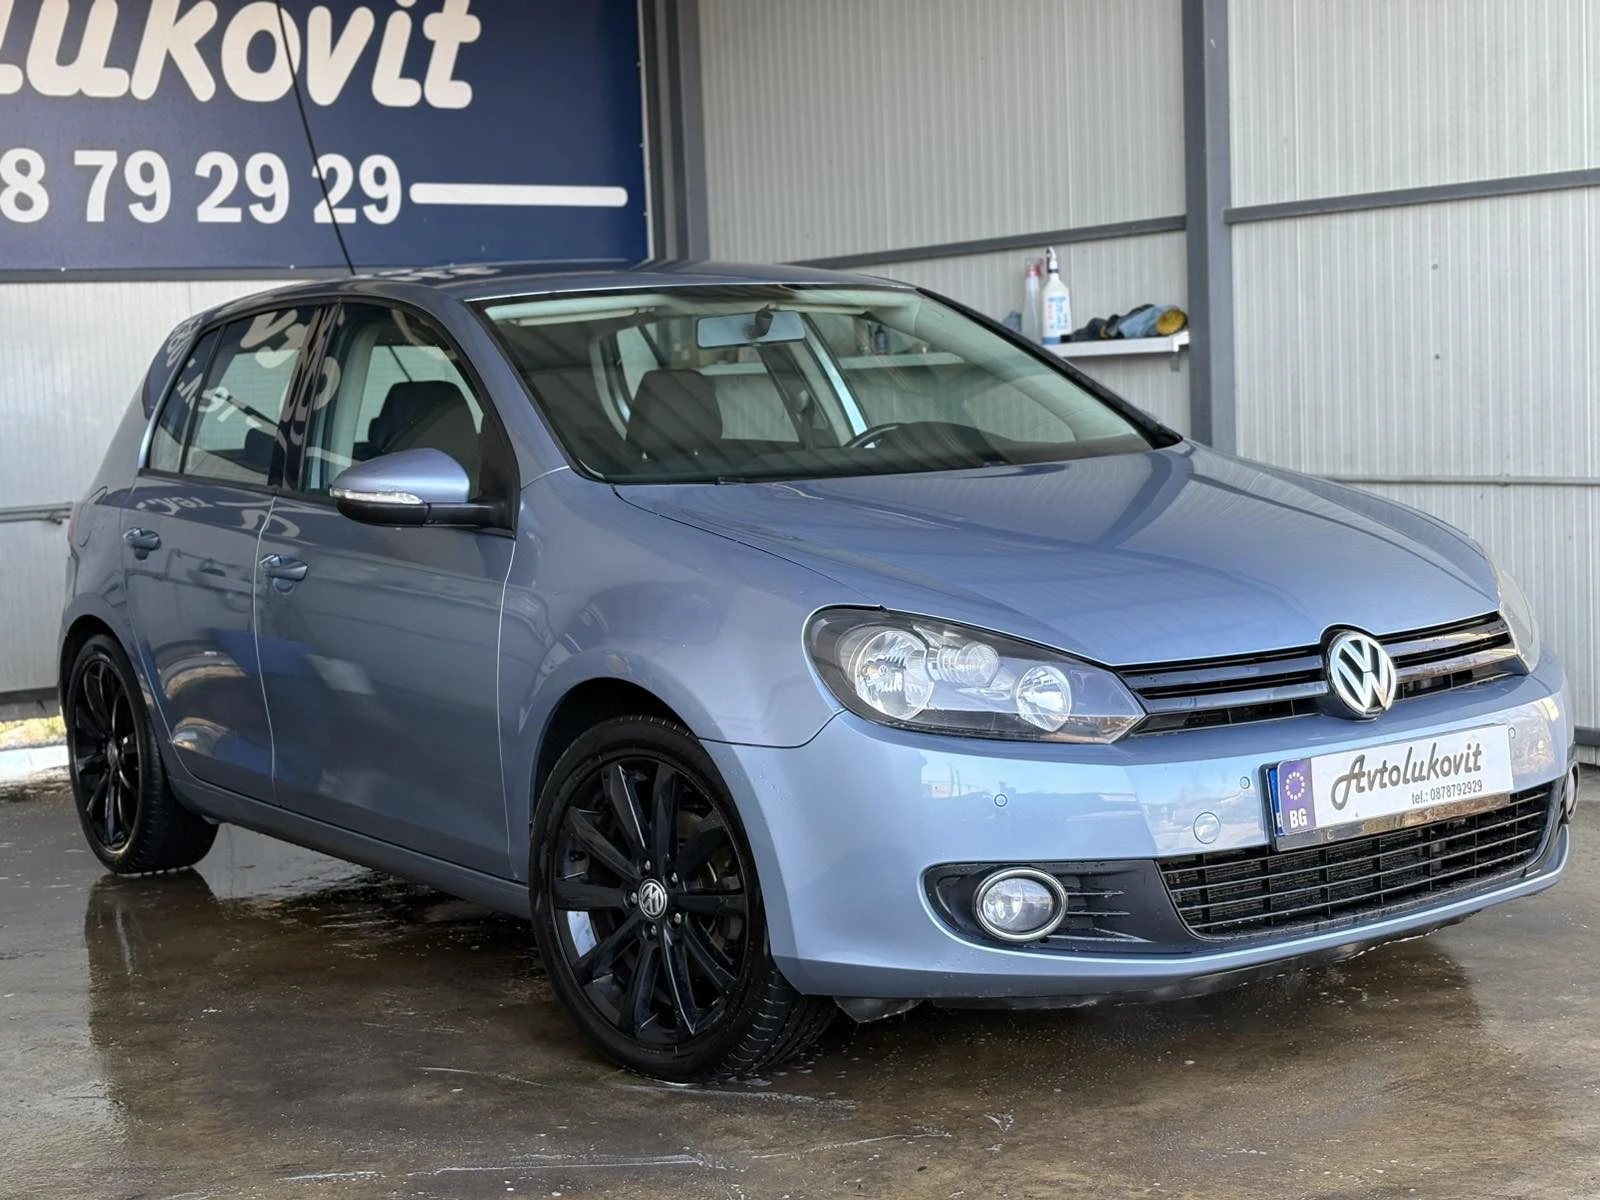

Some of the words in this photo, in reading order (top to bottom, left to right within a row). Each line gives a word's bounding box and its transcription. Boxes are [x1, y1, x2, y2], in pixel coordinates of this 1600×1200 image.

[73, 149, 172, 224] 79
[194, 150, 290, 225] 29
[311, 153, 403, 226] 29
[1330, 742, 1482, 811] Avtolukovit
[1430, 779, 1482, 801] 0878792929
[1289, 807, 1308, 829] BG
